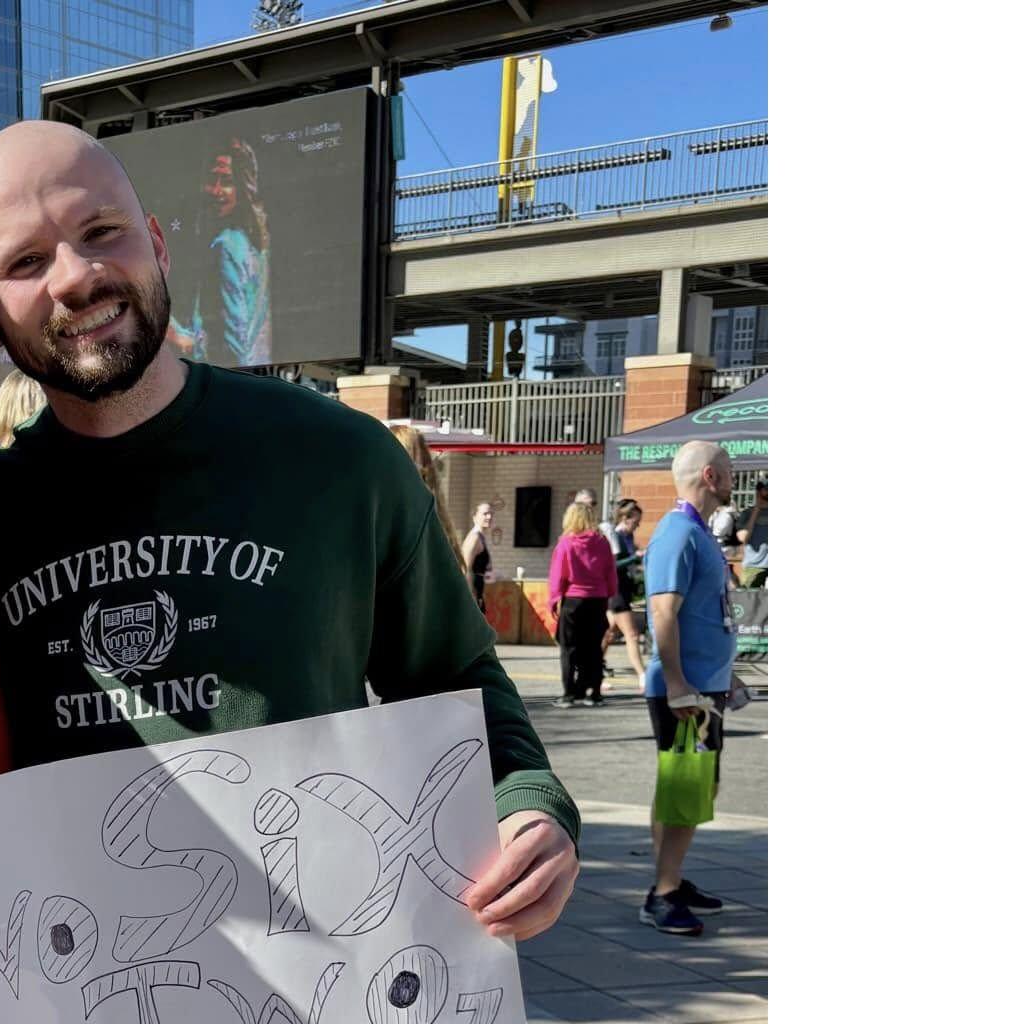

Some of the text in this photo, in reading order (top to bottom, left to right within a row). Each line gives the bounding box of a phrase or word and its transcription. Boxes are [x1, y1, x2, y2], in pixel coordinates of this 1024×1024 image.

[619, 445, 641, 461] THE
[1, 535, 285, 626] UNIVERSITY OF
[47, 615, 217, 655] EST. 1967
[55, 673, 222, 729] STIRLING
